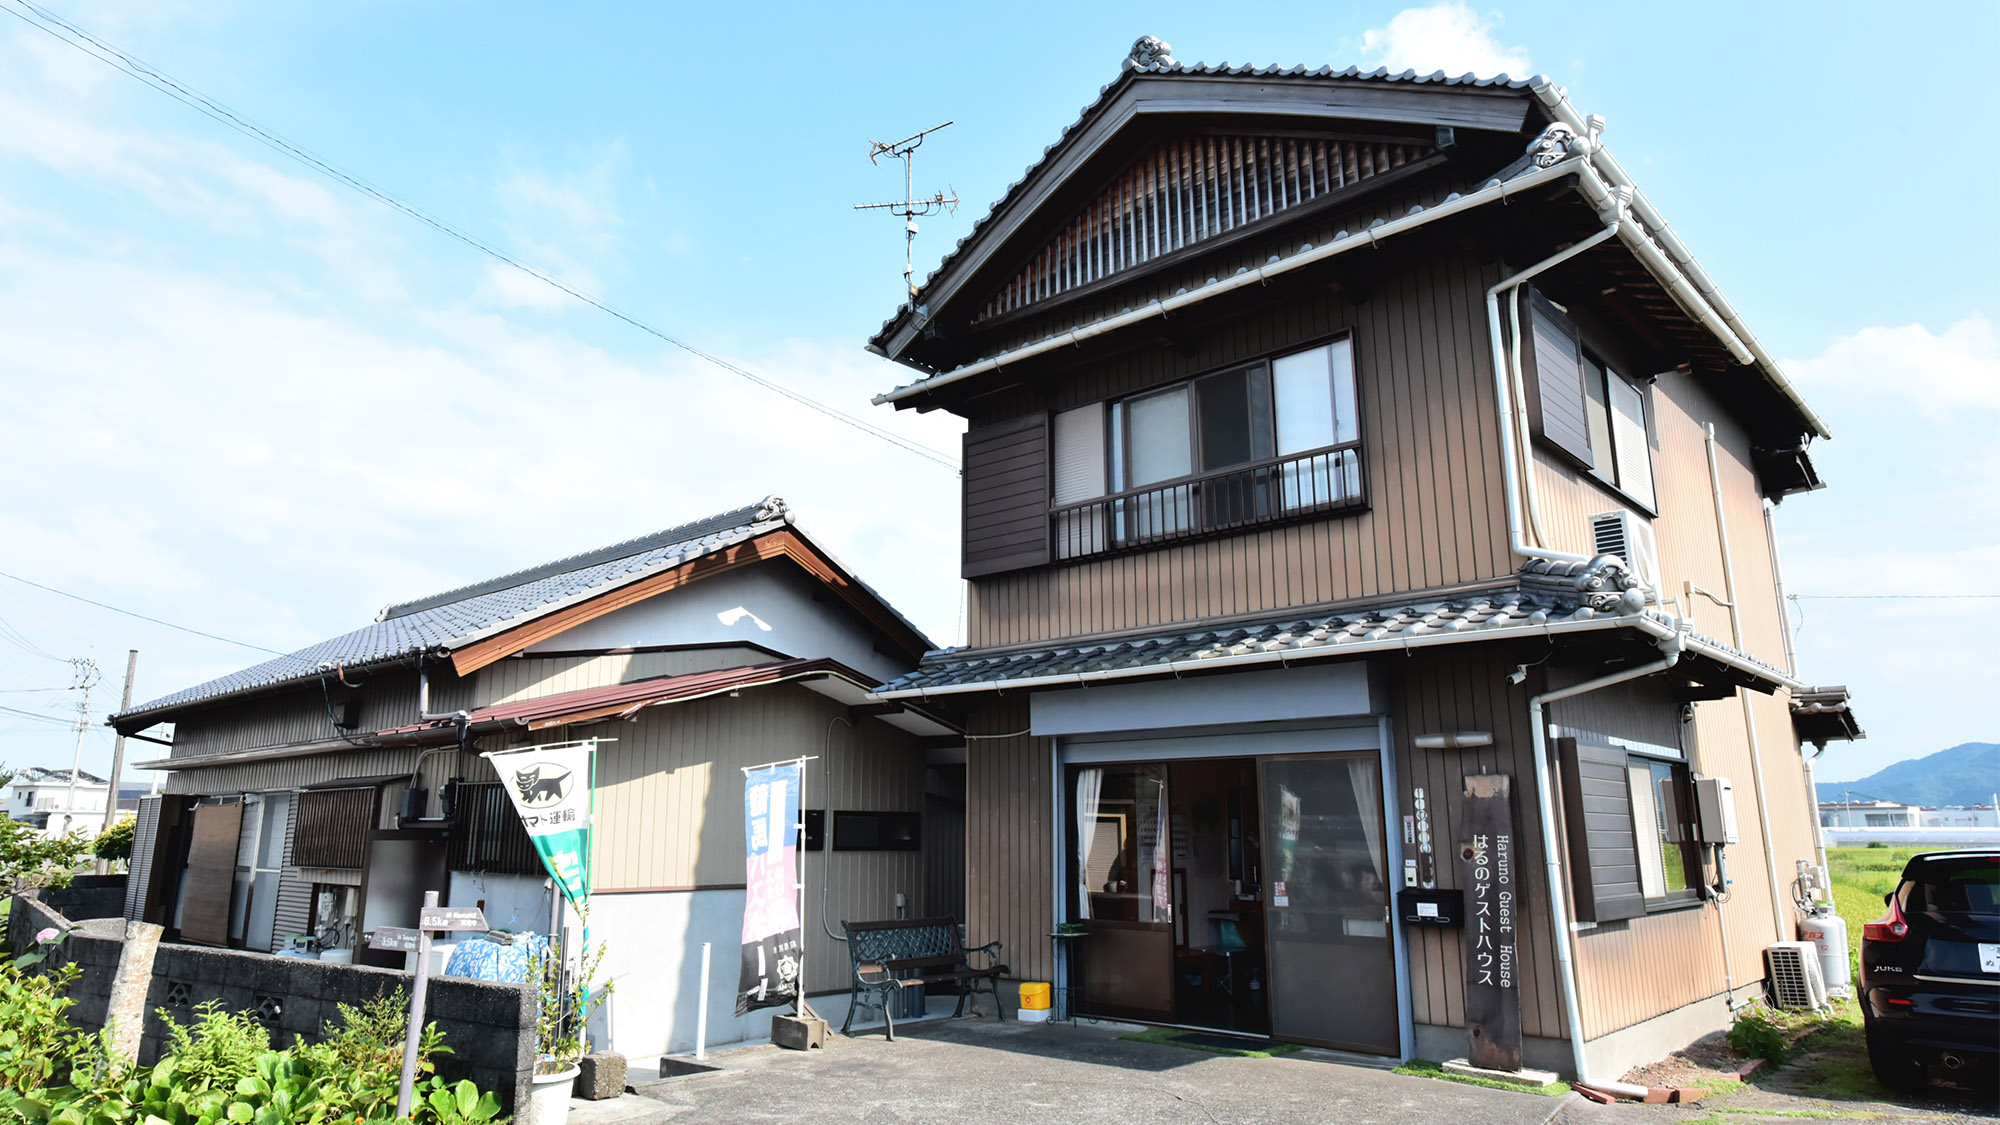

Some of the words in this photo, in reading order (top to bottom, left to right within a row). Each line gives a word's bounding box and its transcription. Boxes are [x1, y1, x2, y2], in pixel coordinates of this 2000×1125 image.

[1496, 835, 1509, 884] Haruno
[1473, 834, 1494, 986] はるのゲストハウス
[1499, 891, 1512, 933] Guest
[1500, 944, 1513, 988] House
[1874, 965, 1903, 973] JUKE
